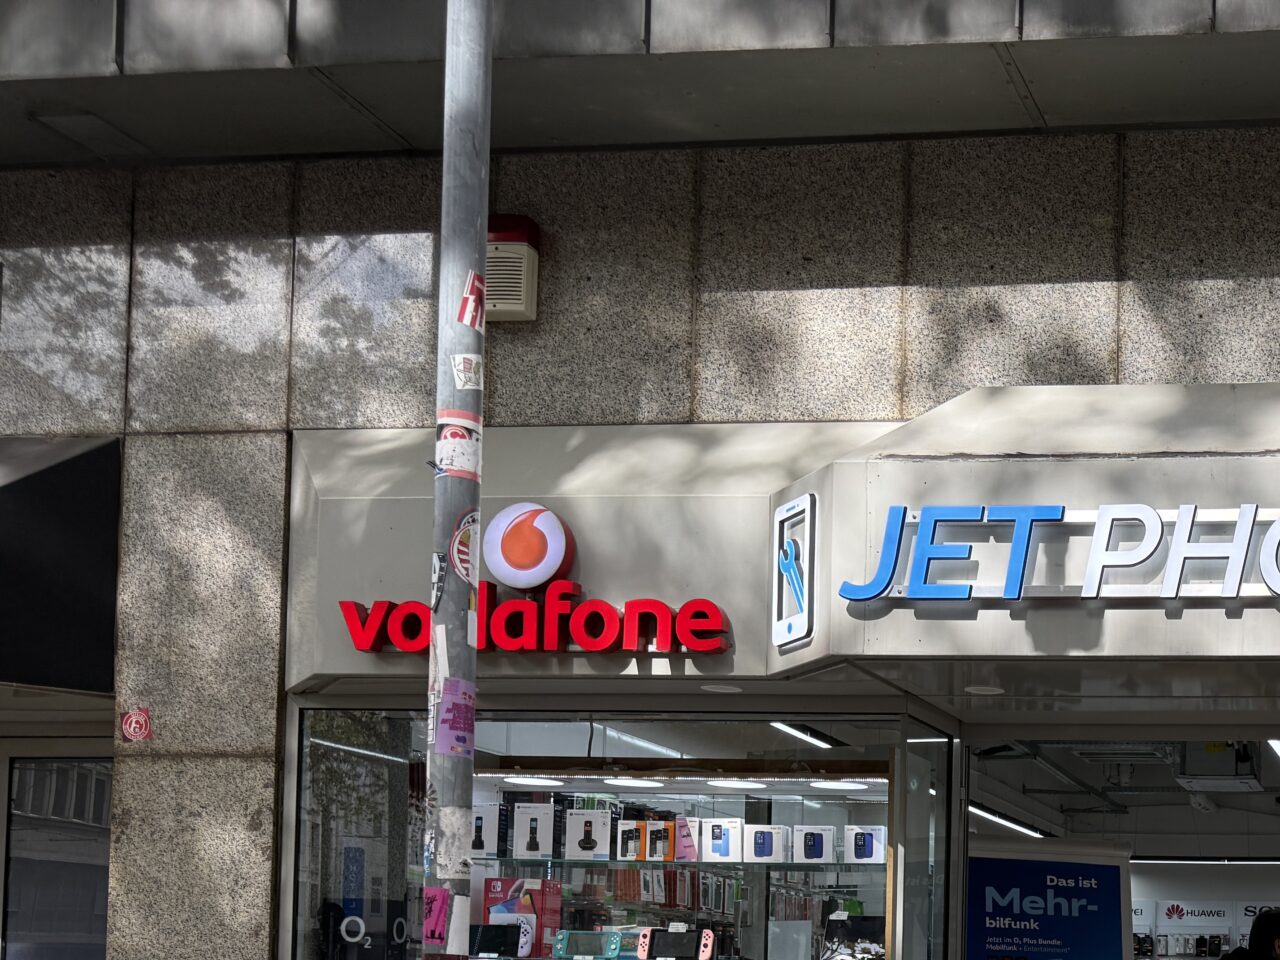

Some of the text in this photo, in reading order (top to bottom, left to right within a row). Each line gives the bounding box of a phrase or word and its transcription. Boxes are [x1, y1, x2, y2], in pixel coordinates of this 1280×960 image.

[838, 504, 1065, 601] JET
[339, 580, 730, 654] voafone
[1046, 874, 1098, 889] Das ist
[985, 886, 1099, 918] Mehr-
[1185, 908, 1226, 919] HUAWEI
[985, 916, 1040, 931] bilfunk
[985, 936, 1002, 944] Jetzt
[1003, 936, 1013, 944] im
[1023, 937, 1037, 945] Plus
[985, 943, 1018, 952] Mobilfunk
